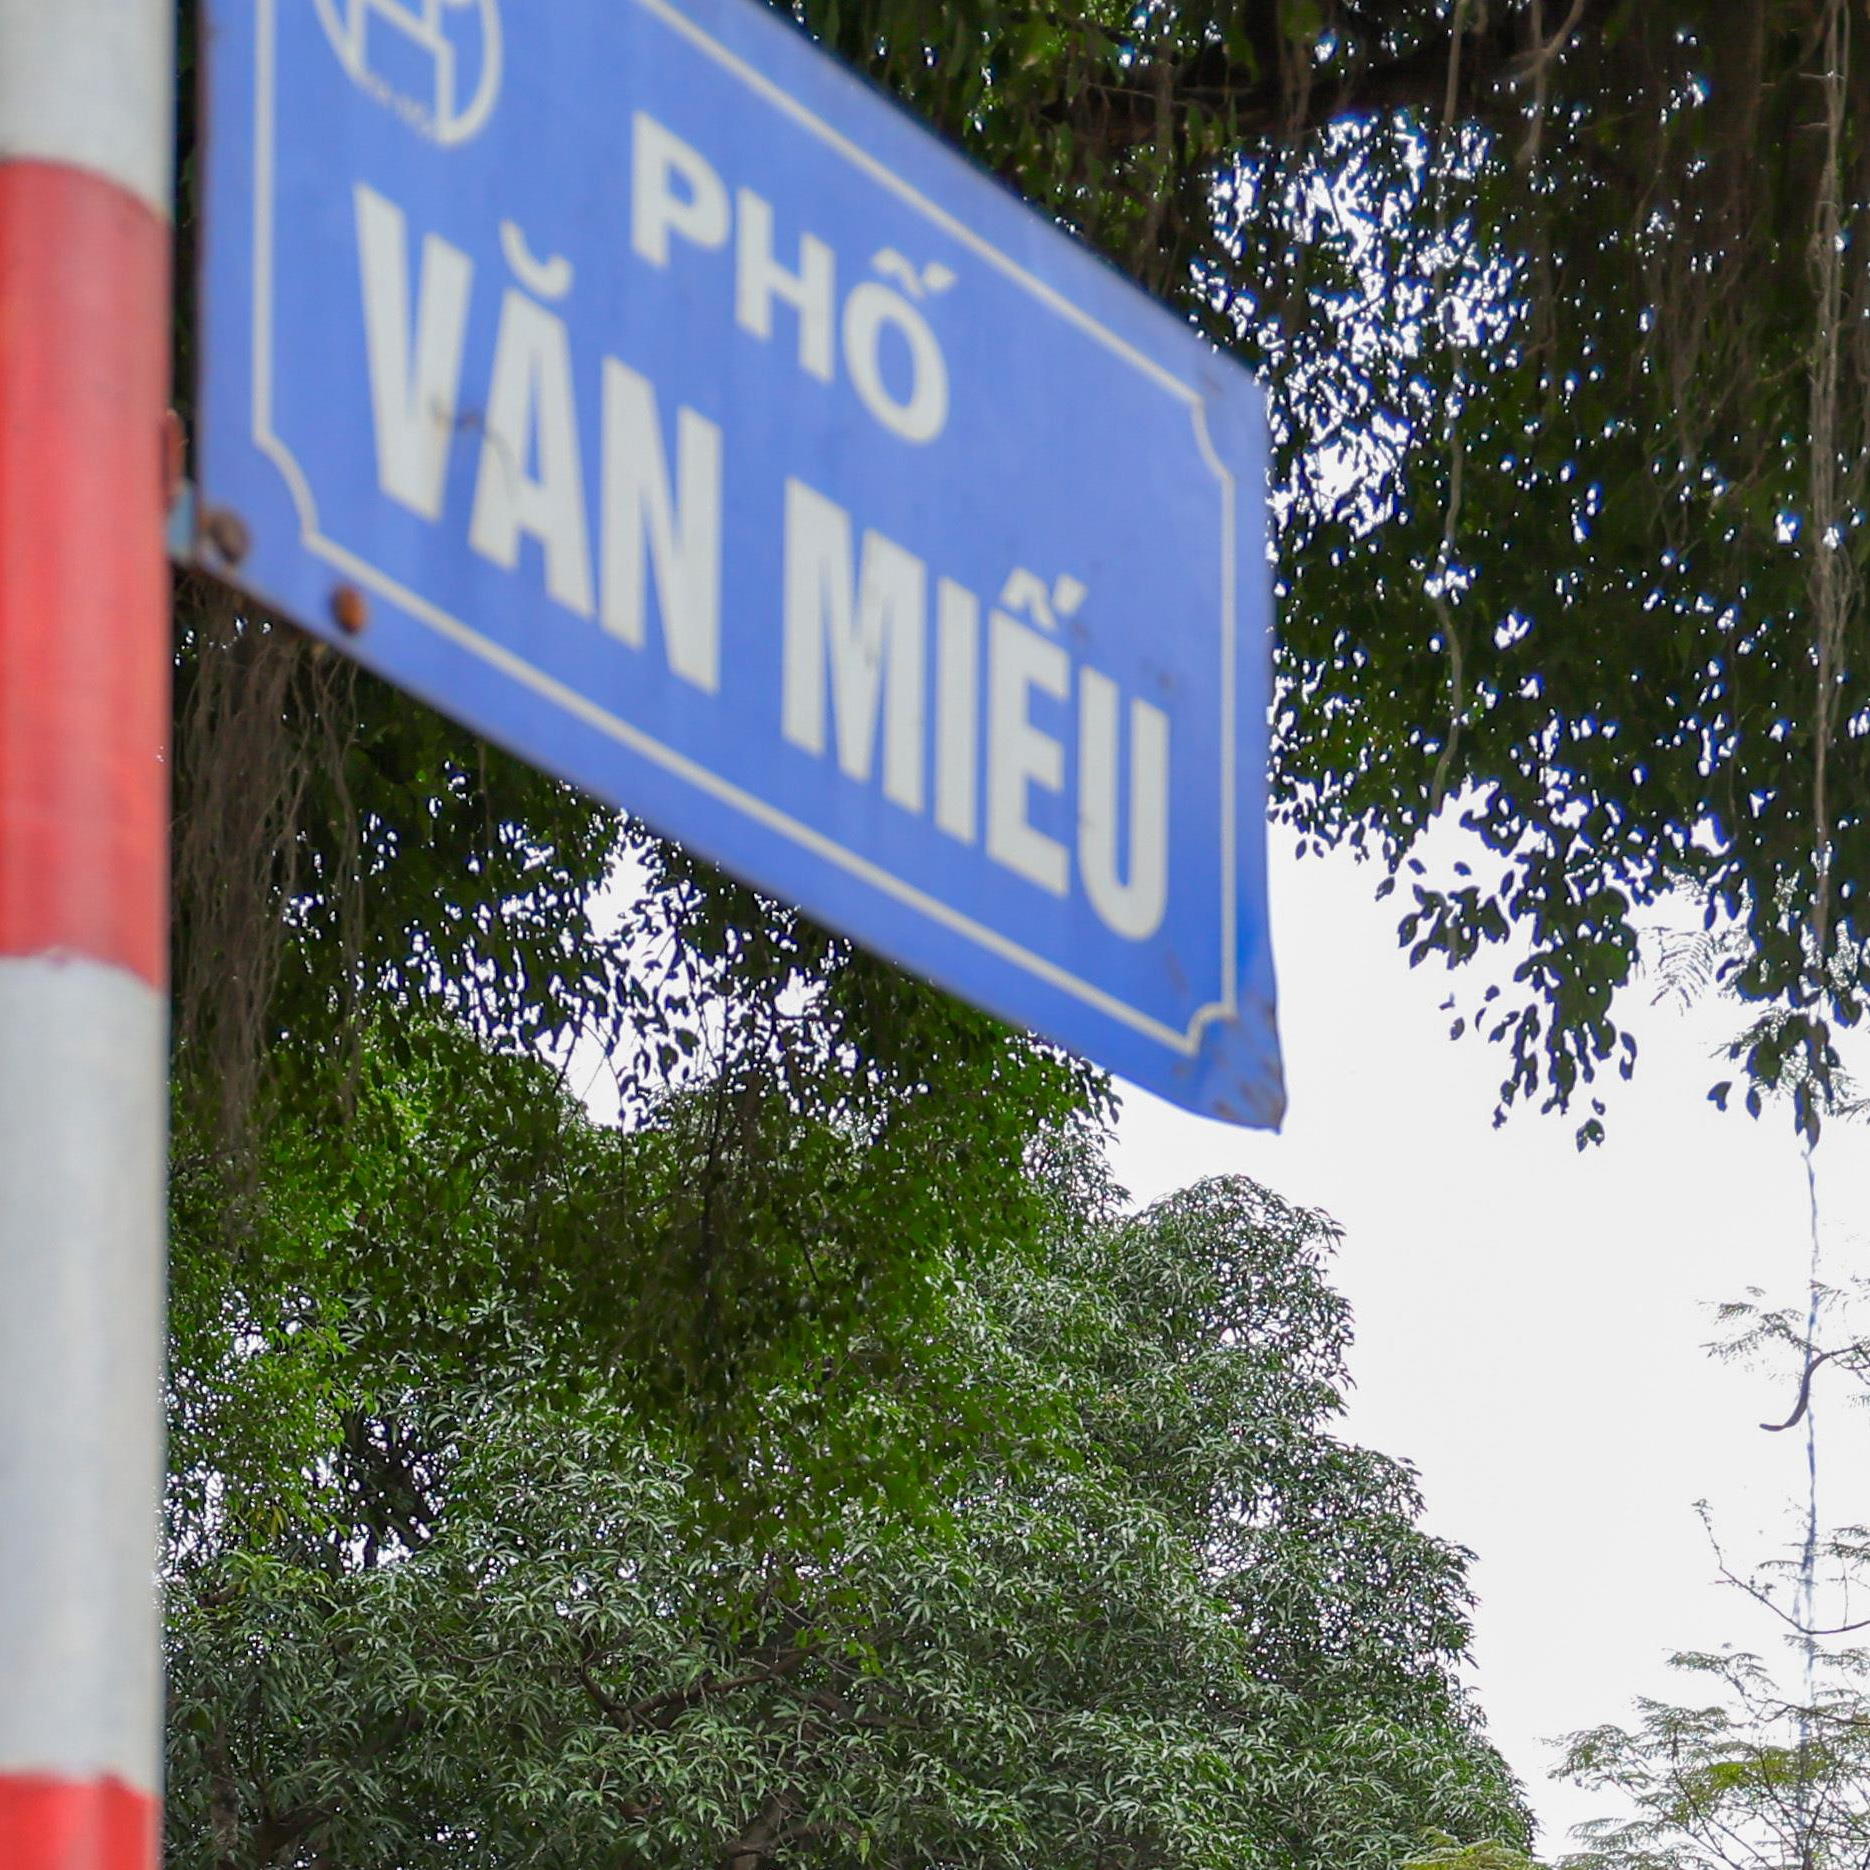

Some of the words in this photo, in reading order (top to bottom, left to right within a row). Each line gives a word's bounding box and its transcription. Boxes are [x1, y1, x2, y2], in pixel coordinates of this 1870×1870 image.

[632, 110, 957, 444] PHỐ
[353, 183, 722, 694] VĂN
[782, 477, 1169, 940] MIẾU
